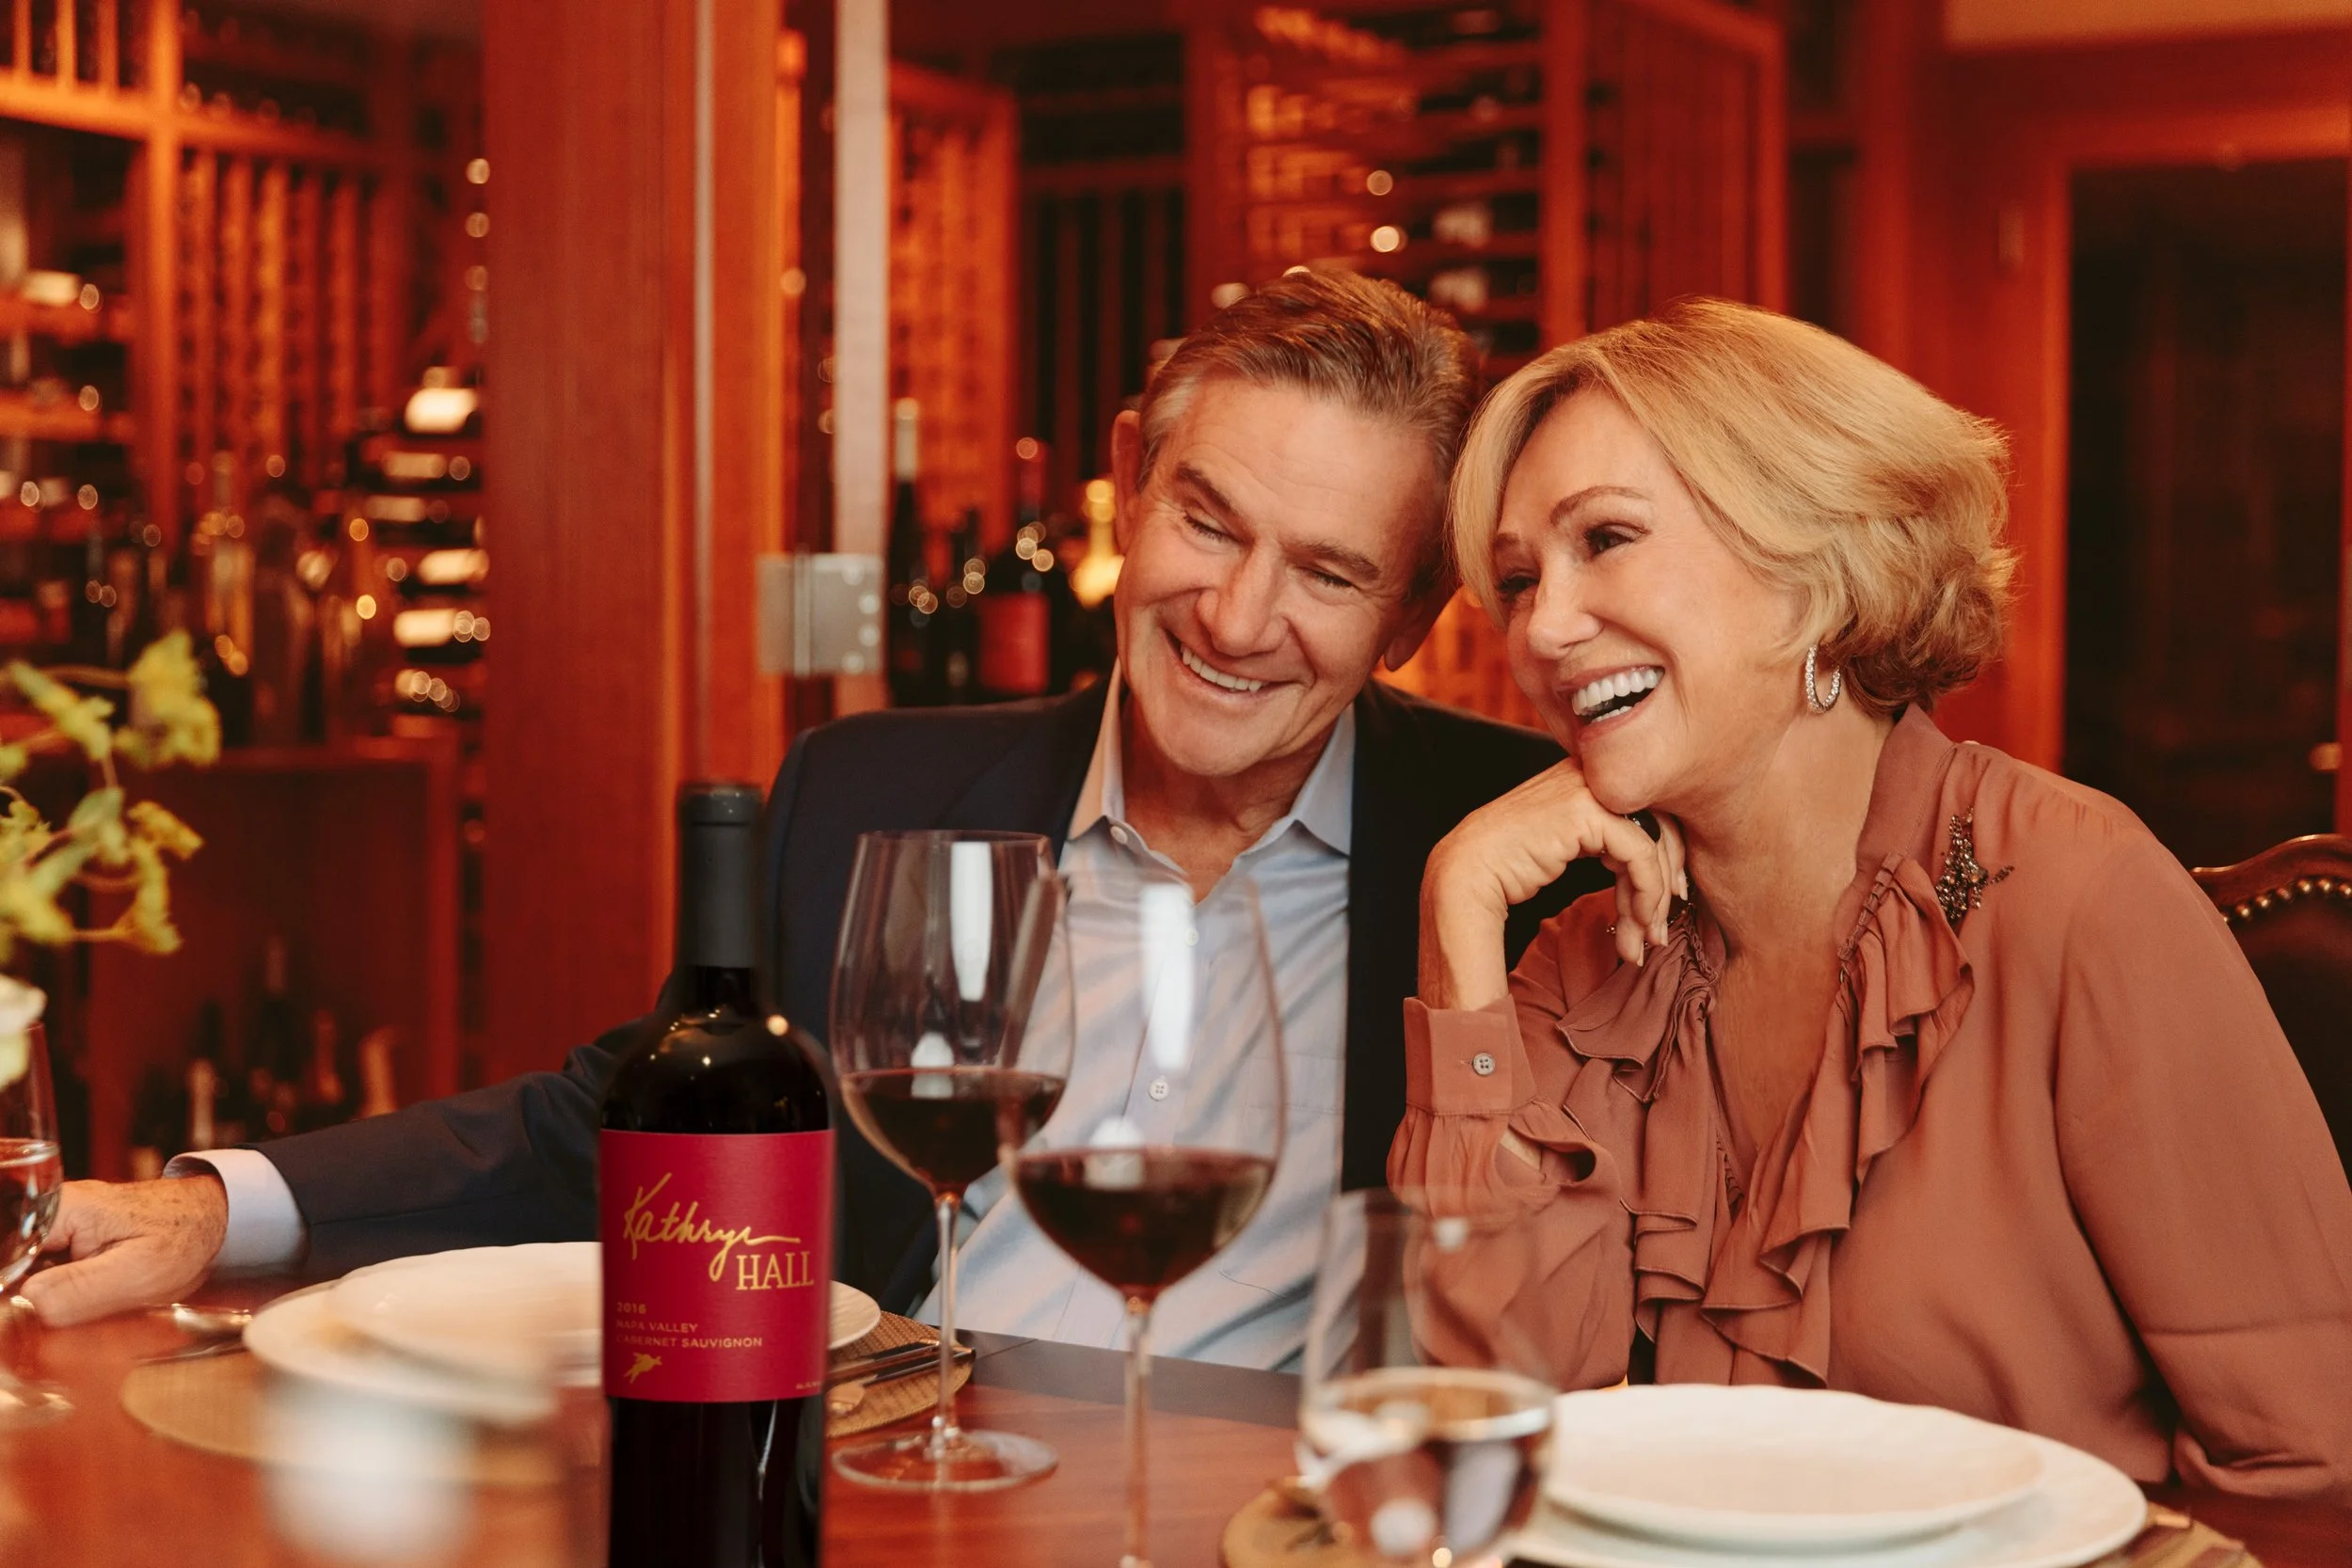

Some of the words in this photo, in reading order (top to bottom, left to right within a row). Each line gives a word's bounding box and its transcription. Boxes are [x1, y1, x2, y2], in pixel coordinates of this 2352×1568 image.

[735, 1251, 815, 1290] HALL
[616, 1320, 645, 1330] NAPA
[648, 1323, 698, 1333] VALLEY
[616, 1335, 676, 1347] CABERNET
[681, 1338, 762, 1348] SAUVIGNON
